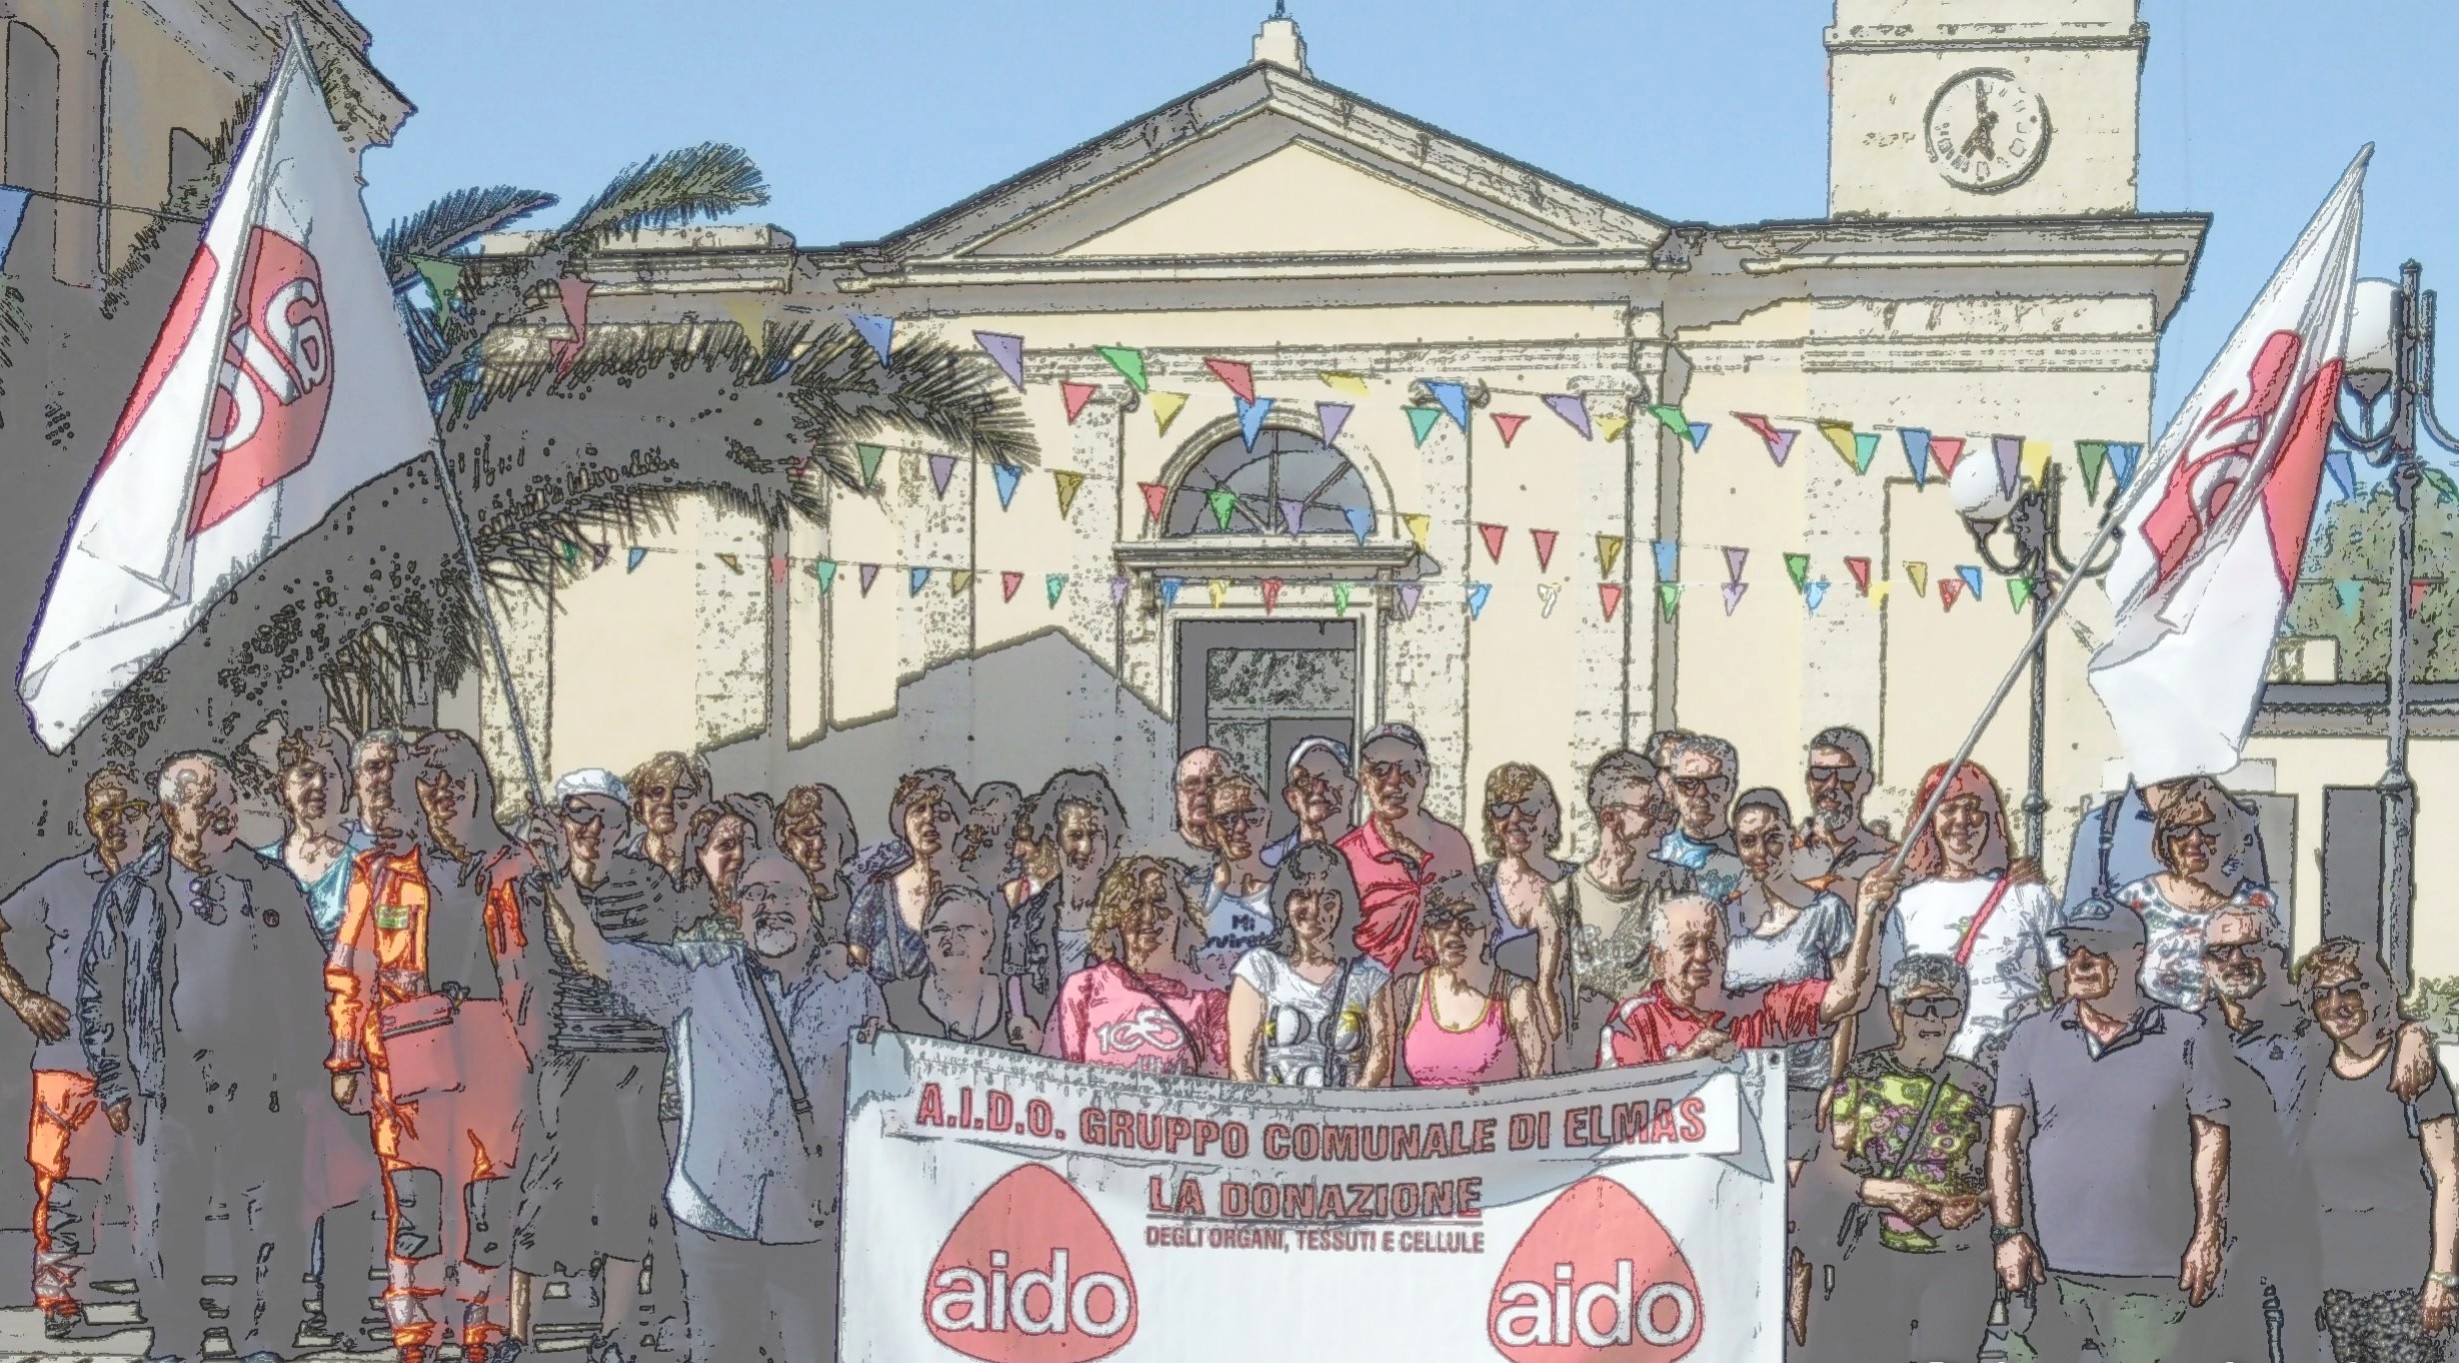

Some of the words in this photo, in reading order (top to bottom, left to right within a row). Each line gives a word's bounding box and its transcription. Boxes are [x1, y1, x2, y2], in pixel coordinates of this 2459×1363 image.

[916, 1081, 1067, 1141] A.I.D.O.
[1079, 1106, 1251, 1159] GRUPPO
[1263, 1118, 1498, 1162] COMUNALE
[1508, 1110, 1551, 1151] DI
[1563, 1096, 1706, 1149] ELMAS
[1149, 1175, 1206, 1216] LA
[1220, 1176, 1483, 1220] DONAZIONE
[1146, 1225, 1203, 1248] DEGLI
[1208, 1227, 1290, 1254] ORGANI,
[1296, 1229, 1376, 1252] TESSUTI
[1382, 1230, 1395, 1252] E
[1400, 1230, 1485, 1254] CELLULE
[930, 1247, 1132, 1338] aido
[1495, 1258, 1697, 1348] aido
